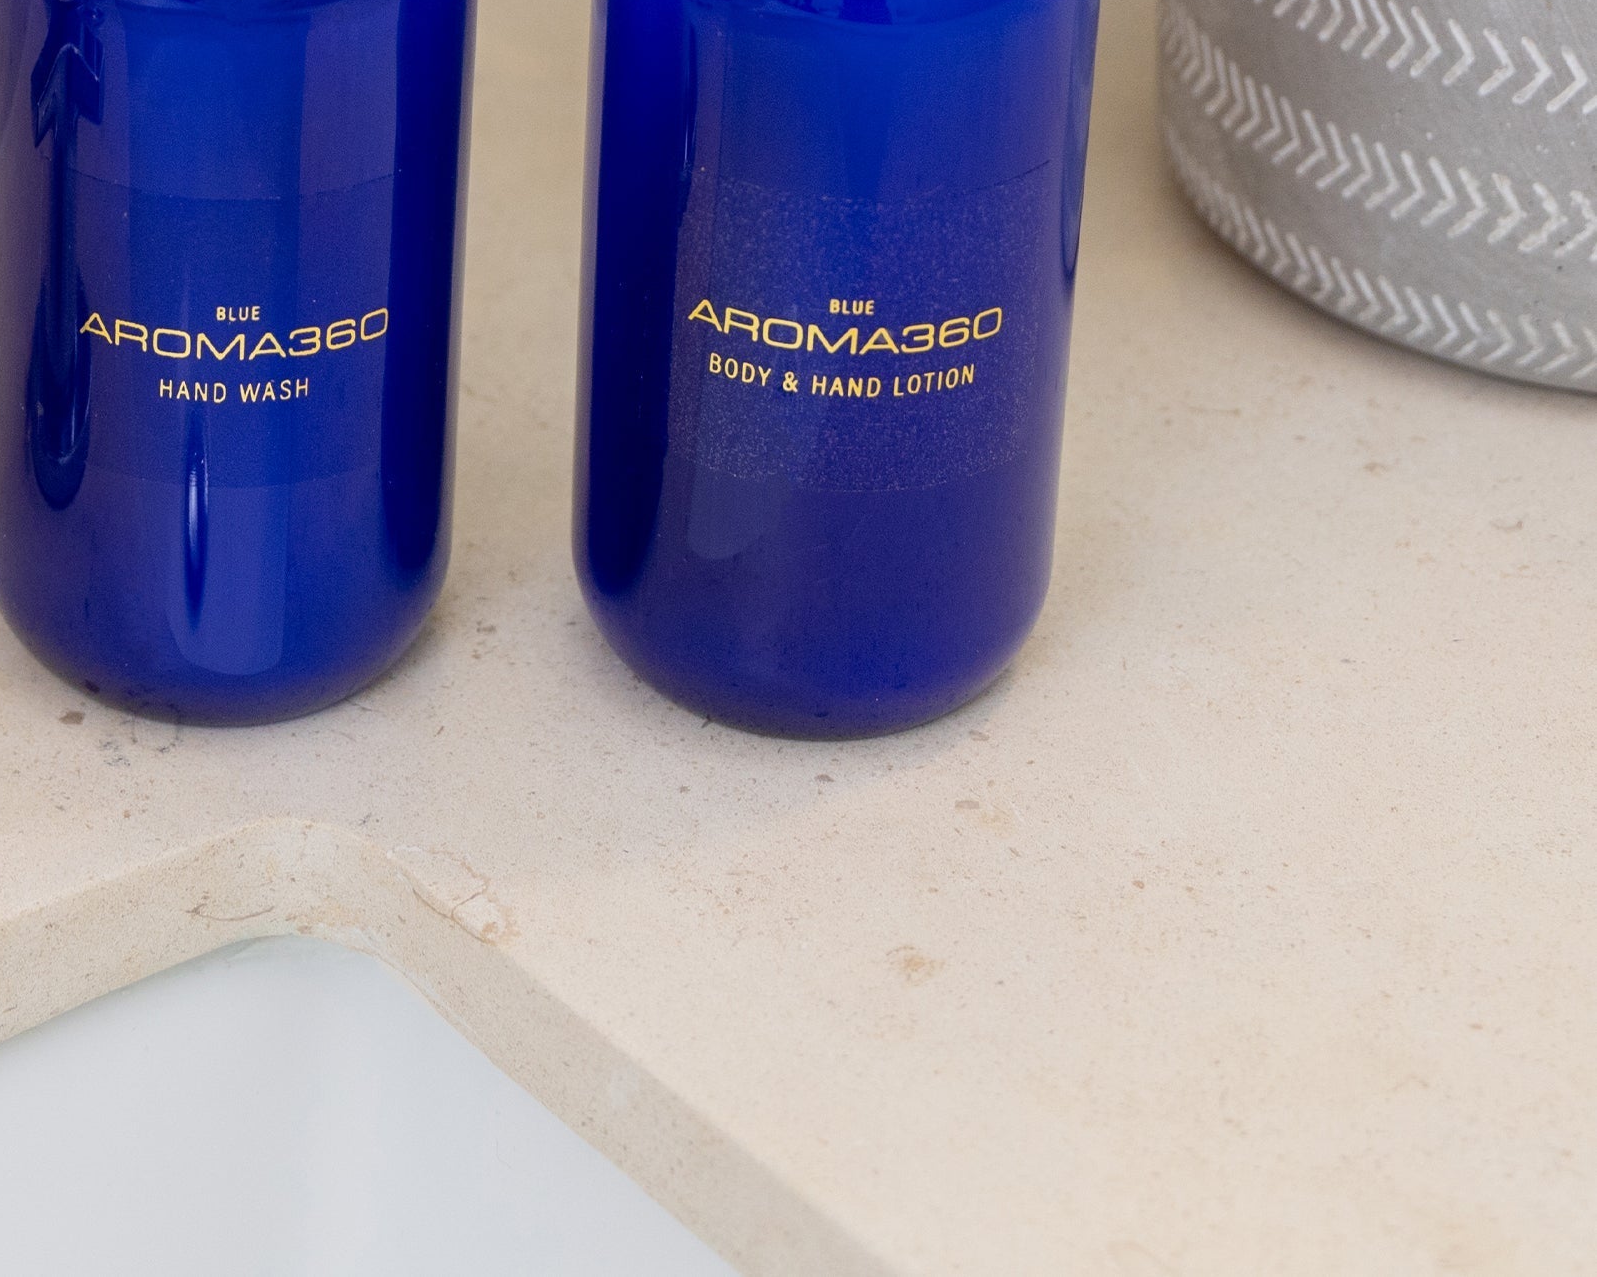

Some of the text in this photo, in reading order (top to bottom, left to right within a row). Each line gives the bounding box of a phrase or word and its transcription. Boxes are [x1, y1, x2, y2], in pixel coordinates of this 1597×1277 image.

[216, 305, 261, 322] BLUE
[829, 298, 875, 316] BLUE
[80, 307, 389, 361] AROMA360
[687, 299, 1003, 356] AROMA360
[159, 377, 309, 404] HAND WASH
[709, 352, 976, 399] BODY & HAND LOTION
